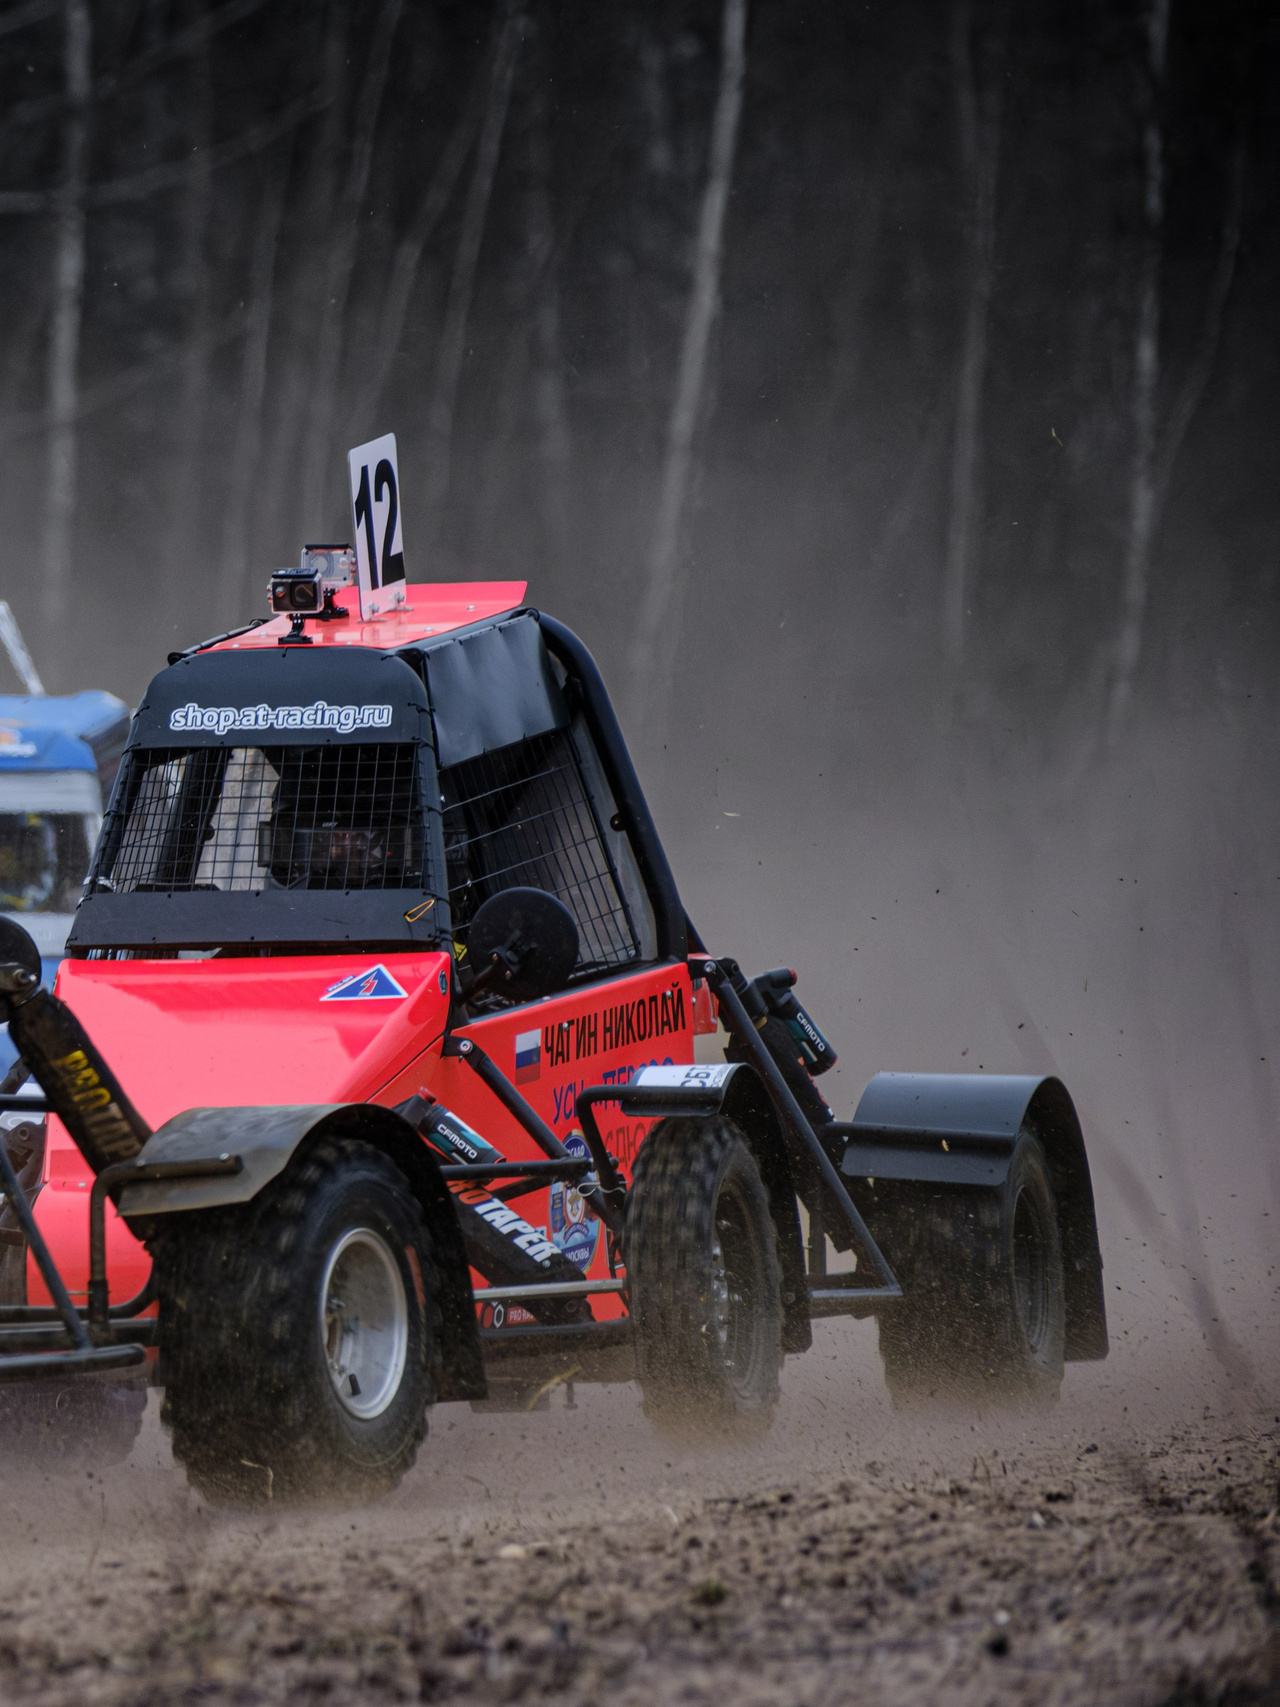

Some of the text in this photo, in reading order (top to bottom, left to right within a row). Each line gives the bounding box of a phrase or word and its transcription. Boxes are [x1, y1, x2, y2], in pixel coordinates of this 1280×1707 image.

[355, 458, 406, 591] 12
[170, 700, 392, 735] shop.at-racing.ru
[545, 981, 686, 1067] ЧАГИН НИКОЛАЙ
[796, 1012, 825, 1052] CFMOTO
[437, 1123, 478, 1160] CFMOTO
